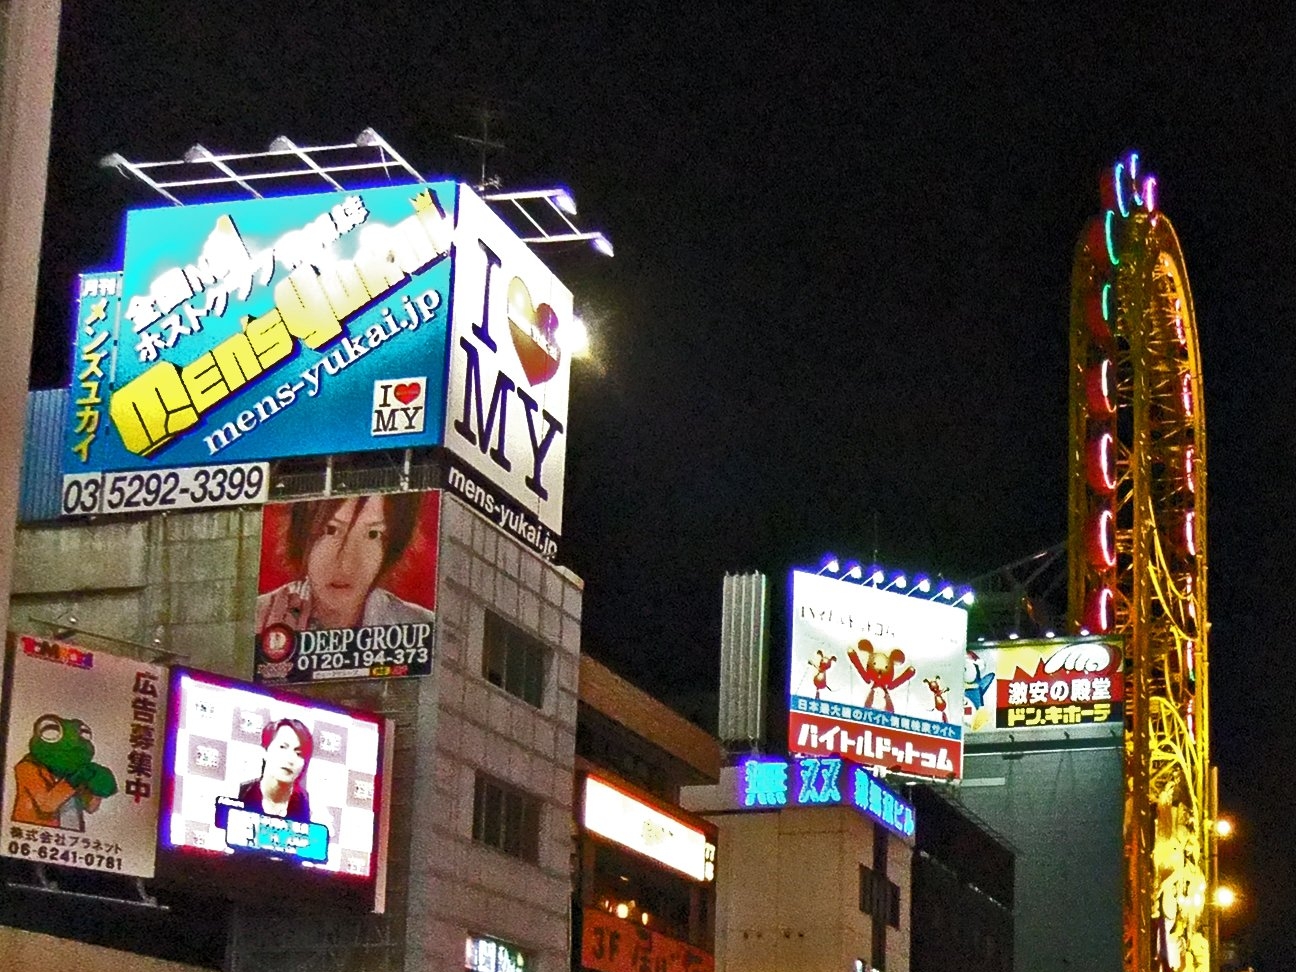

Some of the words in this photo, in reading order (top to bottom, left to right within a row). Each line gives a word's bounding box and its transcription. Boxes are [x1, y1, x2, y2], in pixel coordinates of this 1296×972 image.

[472, 238, 502, 353] I
[70, 299, 110, 462] メンズユカイ
[203, 286, 443, 456] mens-yukai.jp
[380, 384, 389, 407] I
[453, 335, 564, 501] MY
[374, 407, 425, 433] MY
[62, 477, 99, 513] 03
[107, 465, 264, 509] 5292-3399
[447, 464, 558, 560] mens-yukai.jp
[298, 648, 428, 671] 0120-194-373
[302, 628, 355, 655] DEEP
[357, 624, 430, 650] GROUP
[1007, 677, 1112, 705] 激安の殿堂
[798, 723, 953, 772] バイトルドットコム
[8, 845, 123, 871] 06-6241-0781
